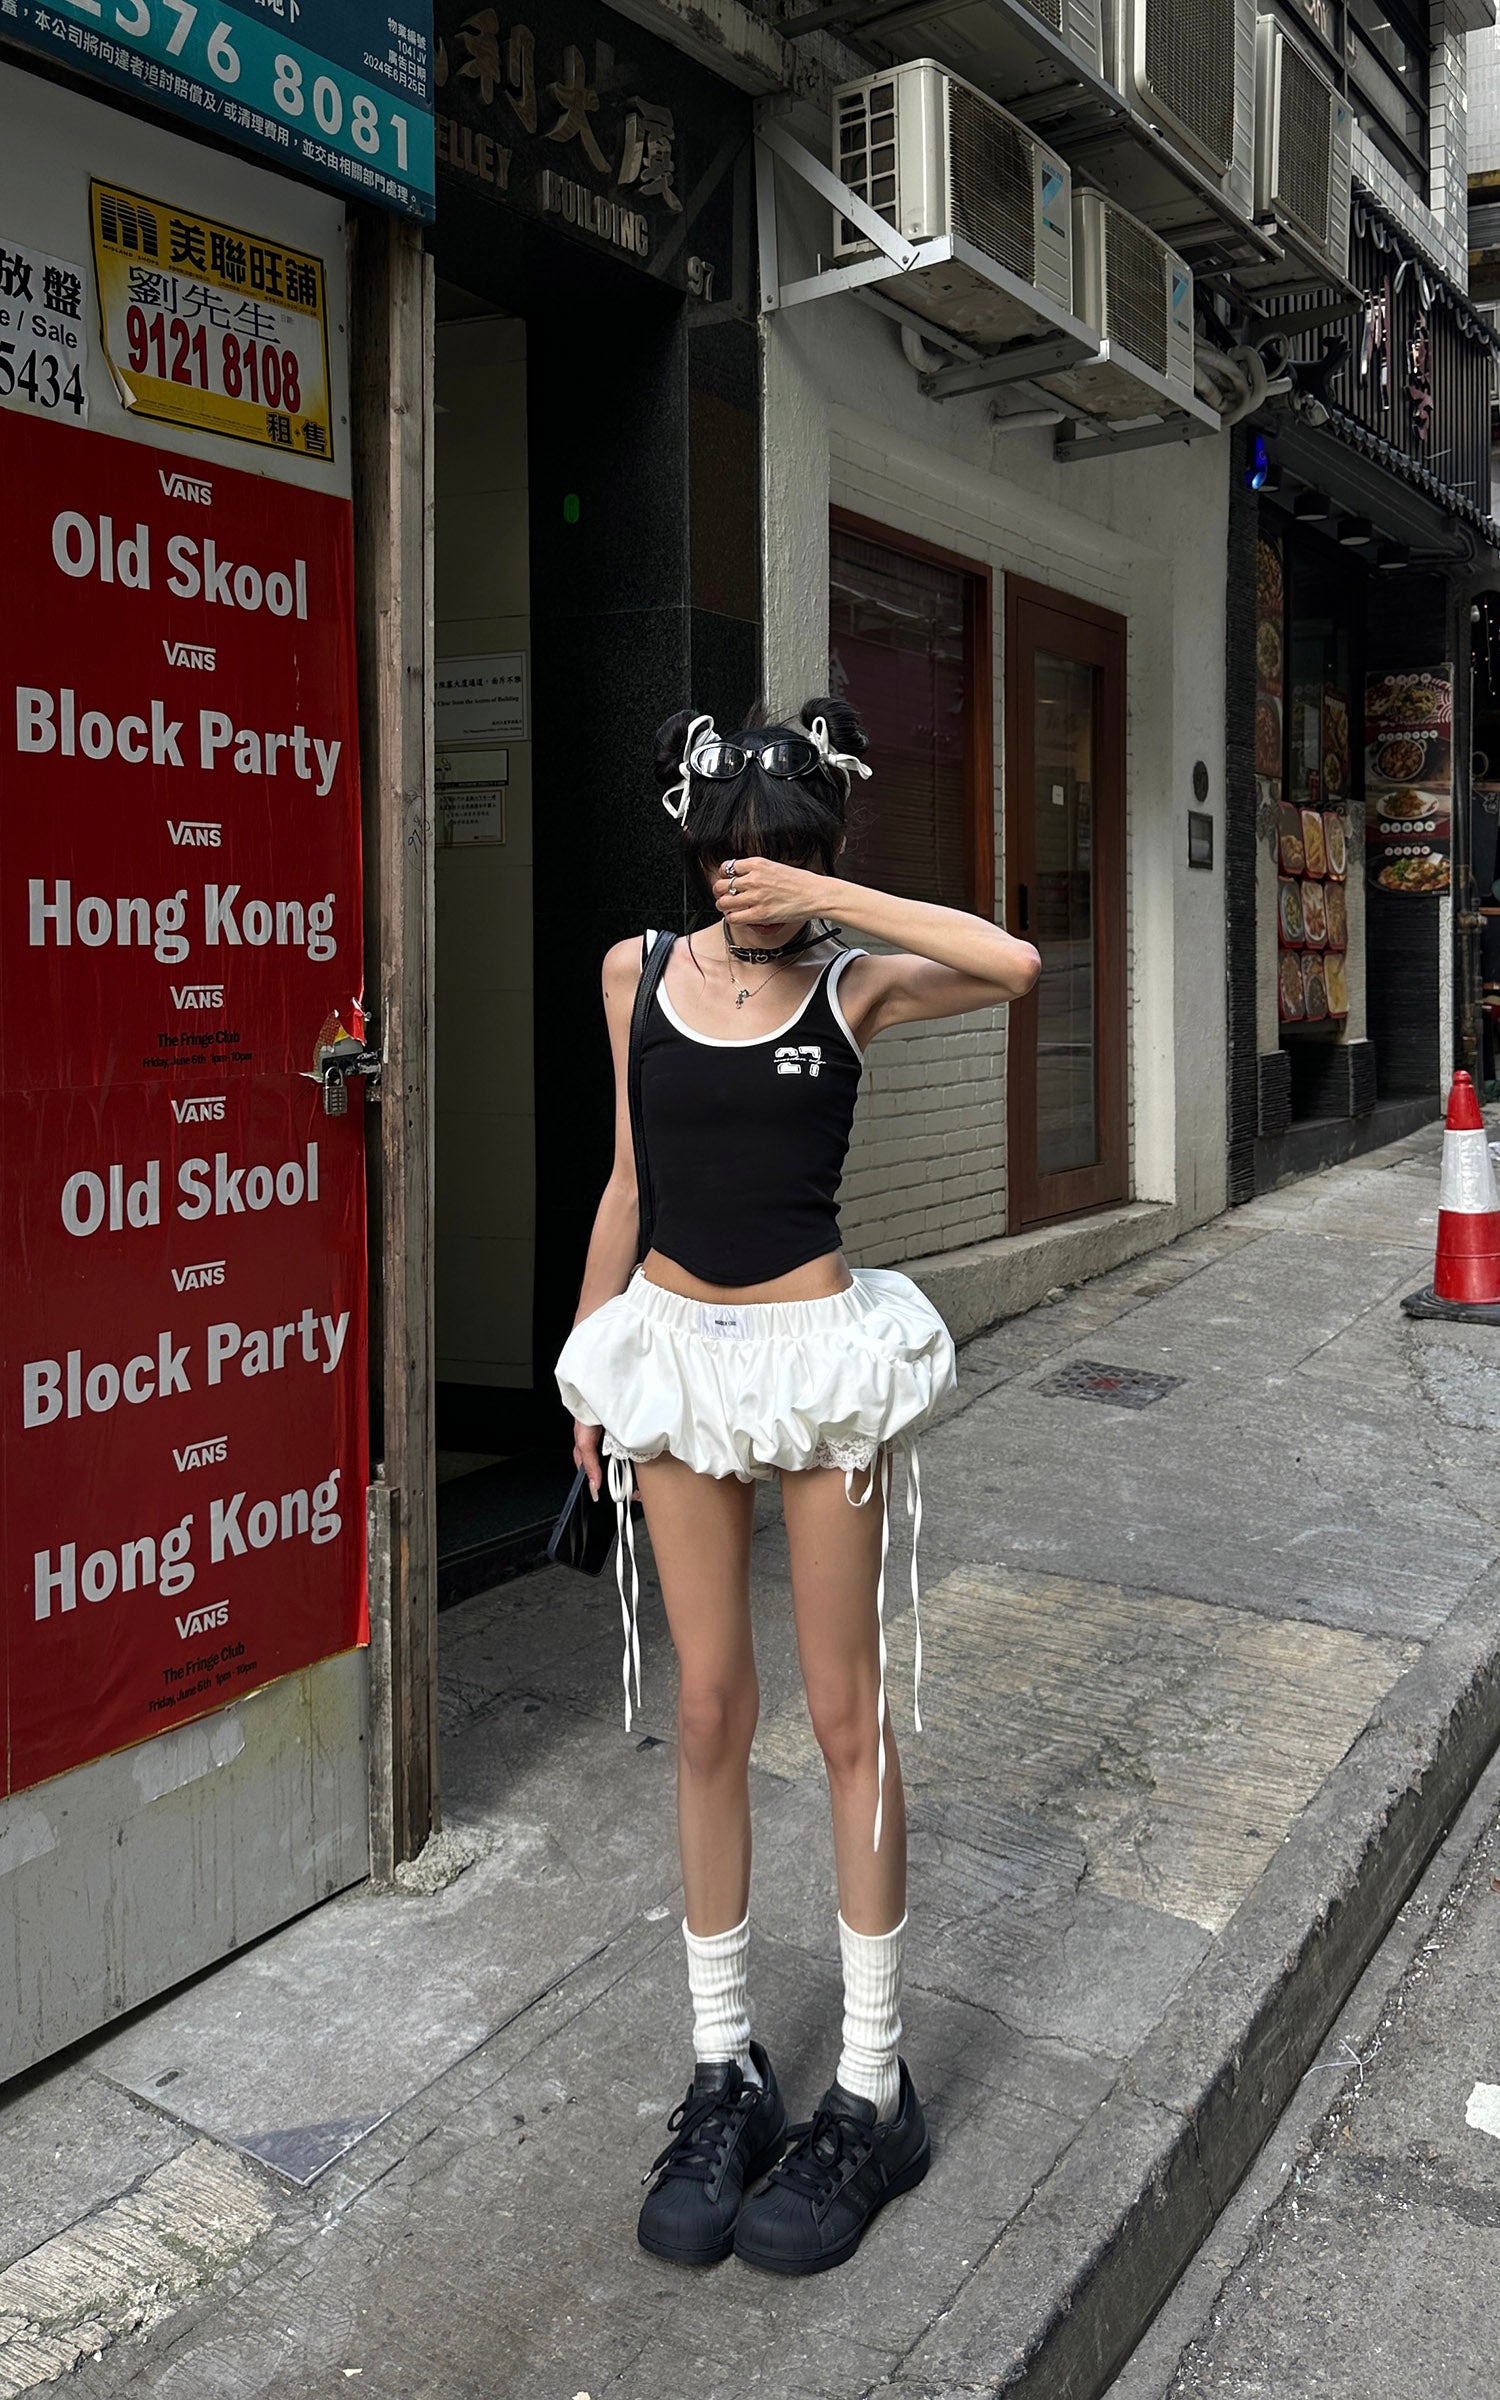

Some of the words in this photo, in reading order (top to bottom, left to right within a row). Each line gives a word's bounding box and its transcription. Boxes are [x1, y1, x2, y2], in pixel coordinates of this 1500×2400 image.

[387, 17, 427, 51] 物業編號
[61, 0, 241, 83] 576
[273, 54, 408, 172] 8081
[363, 51, 426, 98] 2024年6月25日
[388, 49, 427, 82] 廣告日期
[541, 169, 650, 257] BUILDING
[0, 248, 82, 321] 放盤
[169, 218, 317, 308] 美聯旺舖
[687, 256, 715, 302] 97
[128, 265, 281, 344] 劉先生
[31, 314, 78, 348] Sale
[0, 340, 85, 416] 5434
[126, 305, 209, 390] 9121
[222, 333, 301, 413] 8108
[158, 469, 213, 506] VANS
[52, 510, 150, 591] Old
[166, 535, 308, 621] Skool
[162, 640, 217, 672] VANS
[498, 695, 520, 704] Building
[16, 685, 184, 767] Block
[200, 709, 342, 797] Party
[166, 820, 222, 847] VANS
[28, 878, 190, 964] Hong
[204, 884, 337, 962] Kong
[170, 984, 224, 1010] VANS
[143, 1056, 170, 1069] Friday,
[170, 1055, 190, 1066] June
[191, 1053, 206, 1064] 6th
[157, 1033, 178, 1048] The
[181, 1031, 214, 1049] Fringe
[216, 1029, 240, 1044] Club
[170, 1095, 226, 1124] VANS
[61, 1160, 160, 1237] Old
[177, 1142, 319, 1221] Skool
[171, 1260, 226, 1292] VANS
[23, 1331, 191, 1429] Block
[207, 1308, 351, 1386] Party
[172, 1435, 228, 1473] VANS
[34, 1514, 195, 1622] Hong
[210, 1469, 342, 1564] Kong
[175, 1599, 230, 1640] VANS
[162, 1667, 184, 1685] The
[186, 1653, 219, 1675] Fringe
[221, 1641, 245, 1662] Club
[149, 1695, 176, 1713] Friday,
[177, 1685, 197, 1702] June
[197, 1677, 211, 1693] 6th
[215, 1670, 232, 1687] 1pm
[236, 1660, 257, 1676] 10pm
